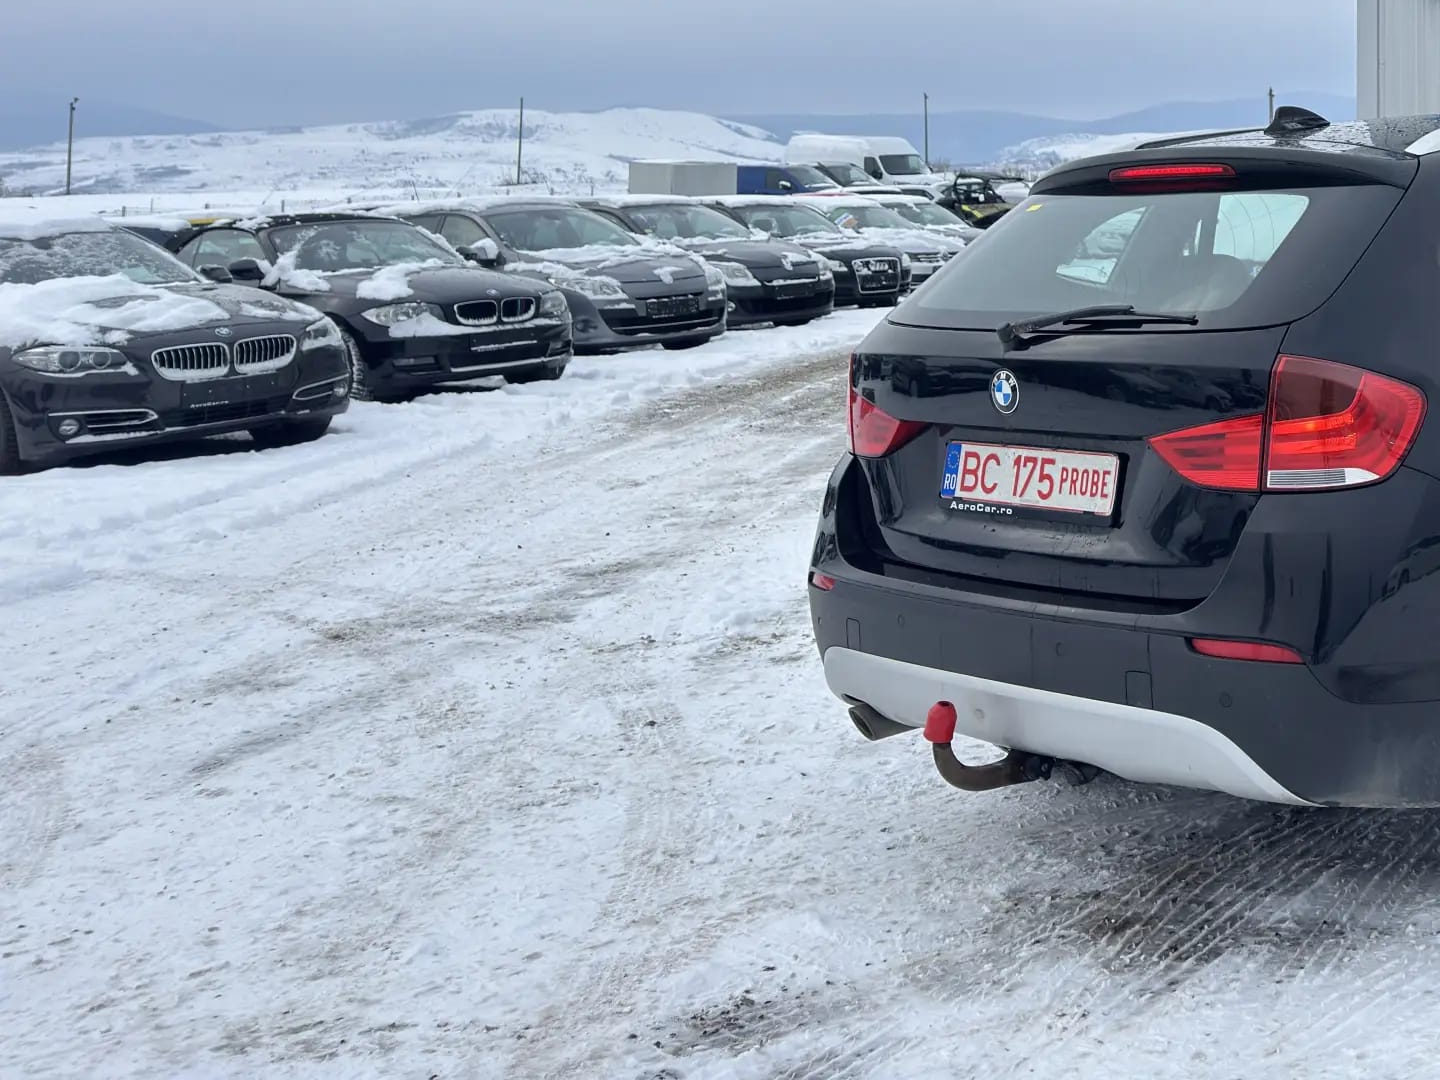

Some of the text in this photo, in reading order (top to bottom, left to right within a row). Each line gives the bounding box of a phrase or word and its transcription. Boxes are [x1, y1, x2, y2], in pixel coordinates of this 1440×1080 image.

[943, 473, 957, 490] RO
[959, 450, 1111, 500] BC 175 PROBE
[950, 500, 1013, 515] AeroCar.ro
